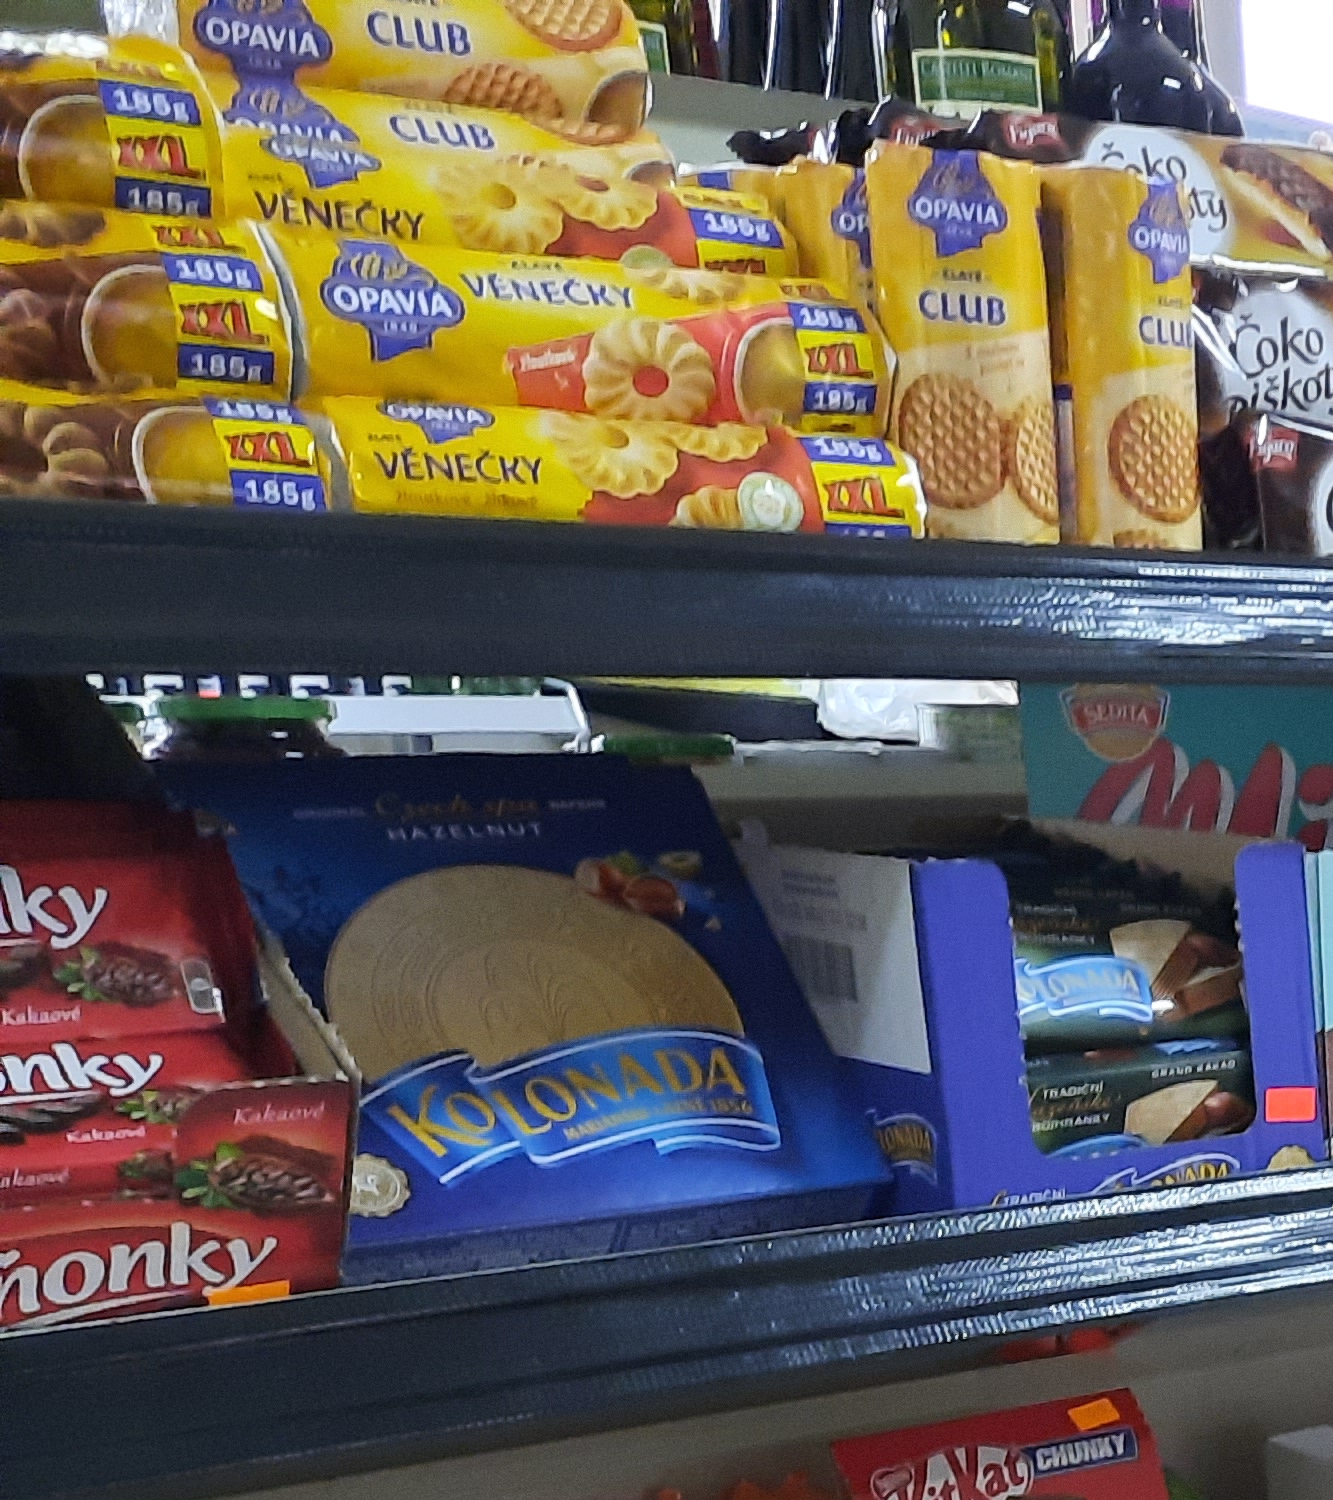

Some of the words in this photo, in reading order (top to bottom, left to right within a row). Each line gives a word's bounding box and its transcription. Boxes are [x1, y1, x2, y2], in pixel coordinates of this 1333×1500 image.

[205, 17, 321, 57] OPAVIA
[366, 11, 472, 56] CLUB
[115, 88, 190, 123] 185g
[389, 115, 496, 151] CLUB
[117, 134, 206, 180] XXL
[254, 188, 424, 240] VĚNEČKY
[915, 196, 999, 226] OPAVIA
[176, 257, 251, 288] 185g
[459, 272, 635, 310] VĚNEČKY
[333, 284, 454, 318] OPAVIA
[919, 290, 1007, 327] CLUB
[180, 301, 270, 344] XXL
[806, 343, 874, 378] XXL
[1234, 312, 1324, 378] Čoko
[191, 353, 261, 383] 185g
[226, 432, 313, 467] XXL
[373, 448, 542, 486] VĚNEČKY
[245, 479, 316, 511] 185g
[825, 479, 904, 519] XXL
[386, 822, 542, 842] HAZELNUT
[233, 1103, 325, 1126] Kakaové
[387, 1047, 745, 1158] KOLONADA
[1036, 1432, 1124, 1470] CHUNKY
